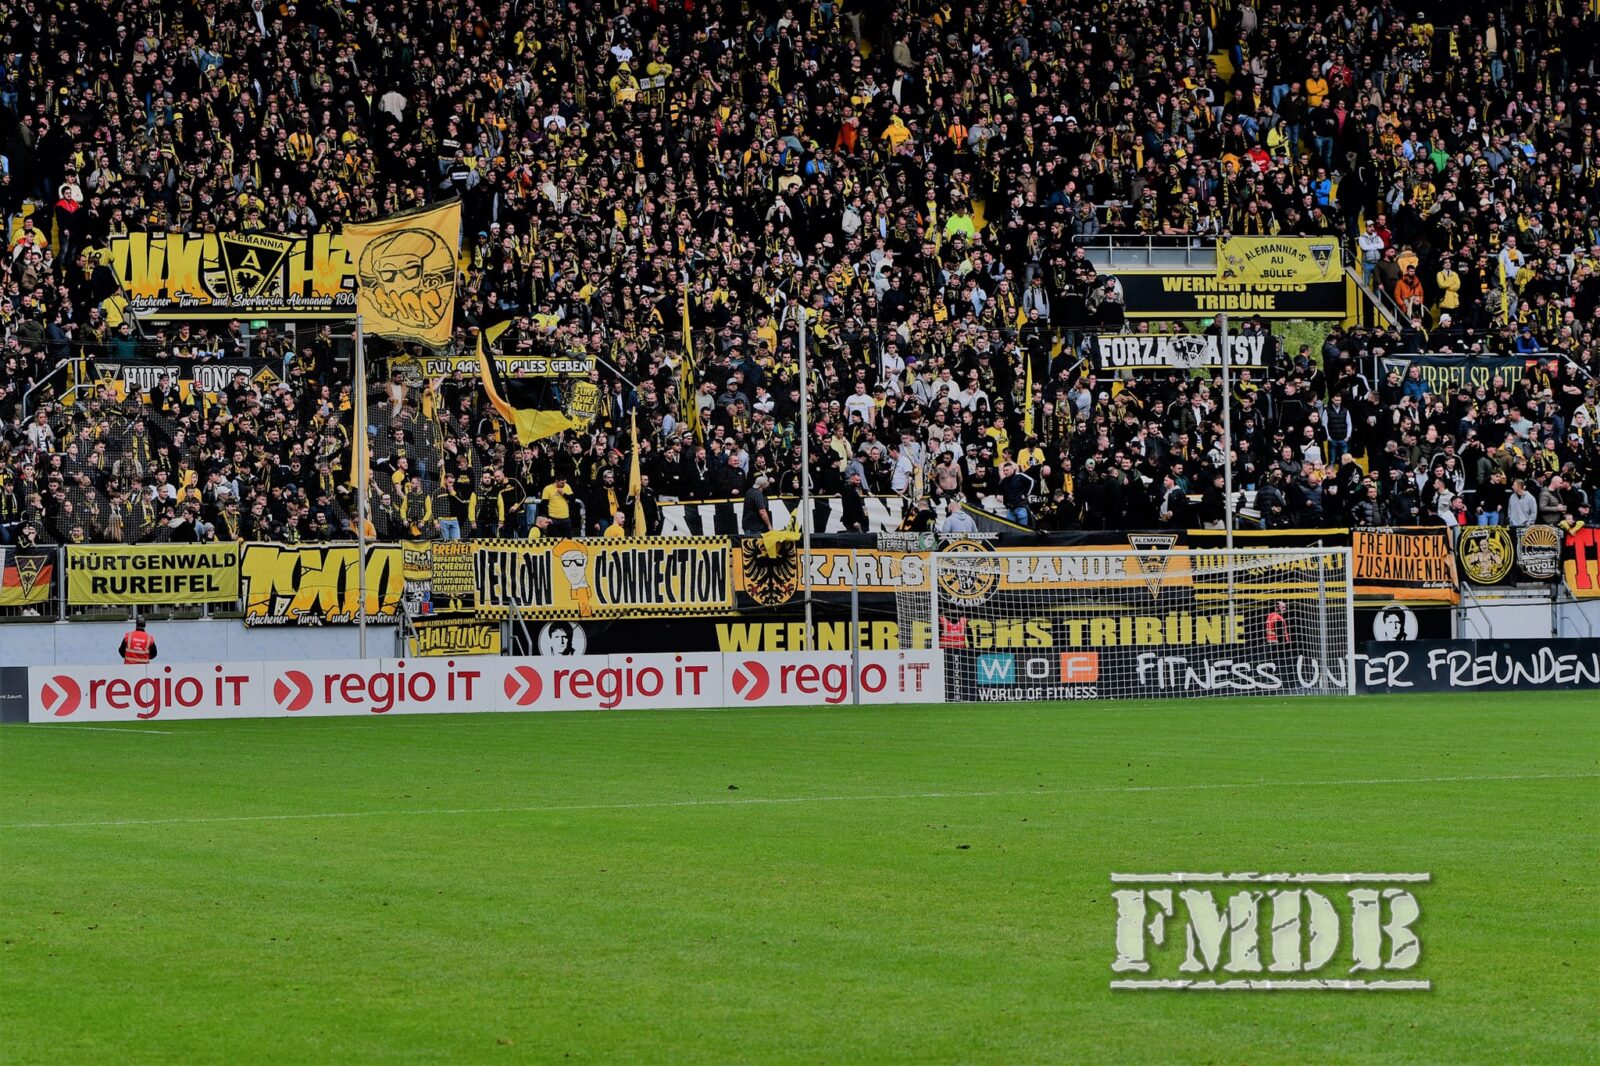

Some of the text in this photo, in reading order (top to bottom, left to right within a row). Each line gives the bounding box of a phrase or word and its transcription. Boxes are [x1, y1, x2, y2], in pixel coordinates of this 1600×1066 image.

[1270, 256, 1284, 265] AU
[131, 294, 172, 306] Aachener
[335, 291, 358, 306] 190
[1194, 293, 1276, 310] TRIBÜNE
[1098, 336, 1168, 367] FORZA
[426, 359, 452, 374] FÜR
[456, 359, 508, 374] AACN
[510, 359, 547, 374] ALLES
[70, 552, 237, 570] HÜRTGENWALD
[799, 555, 1128, 587] KARLS BANDE
[1356, 554, 1451, 580] ZUSAMMENHA
[91, 574, 220, 594] RUREIFEL
[474, 547, 552, 606] YELLOW
[594, 546, 728, 605] CONNECTION
[246, 613, 289, 625] Aachener
[332, 611, 350, 624] und
[717, 611, 1246, 651] WERNER FCHS TRIBÜNE
[420, 626, 490, 650] HALTUNG
[780, 652, 887, 704] rego
[1136, 652, 1283, 690] FITNESS
[1426, 646, 1600, 690] FREUNDEN
[90, 666, 204, 719] regio
[324, 660, 436, 714] regio
[554, 656, 664, 709] regio
[979, 686, 1098, 701] WORLD OF FITNESS
